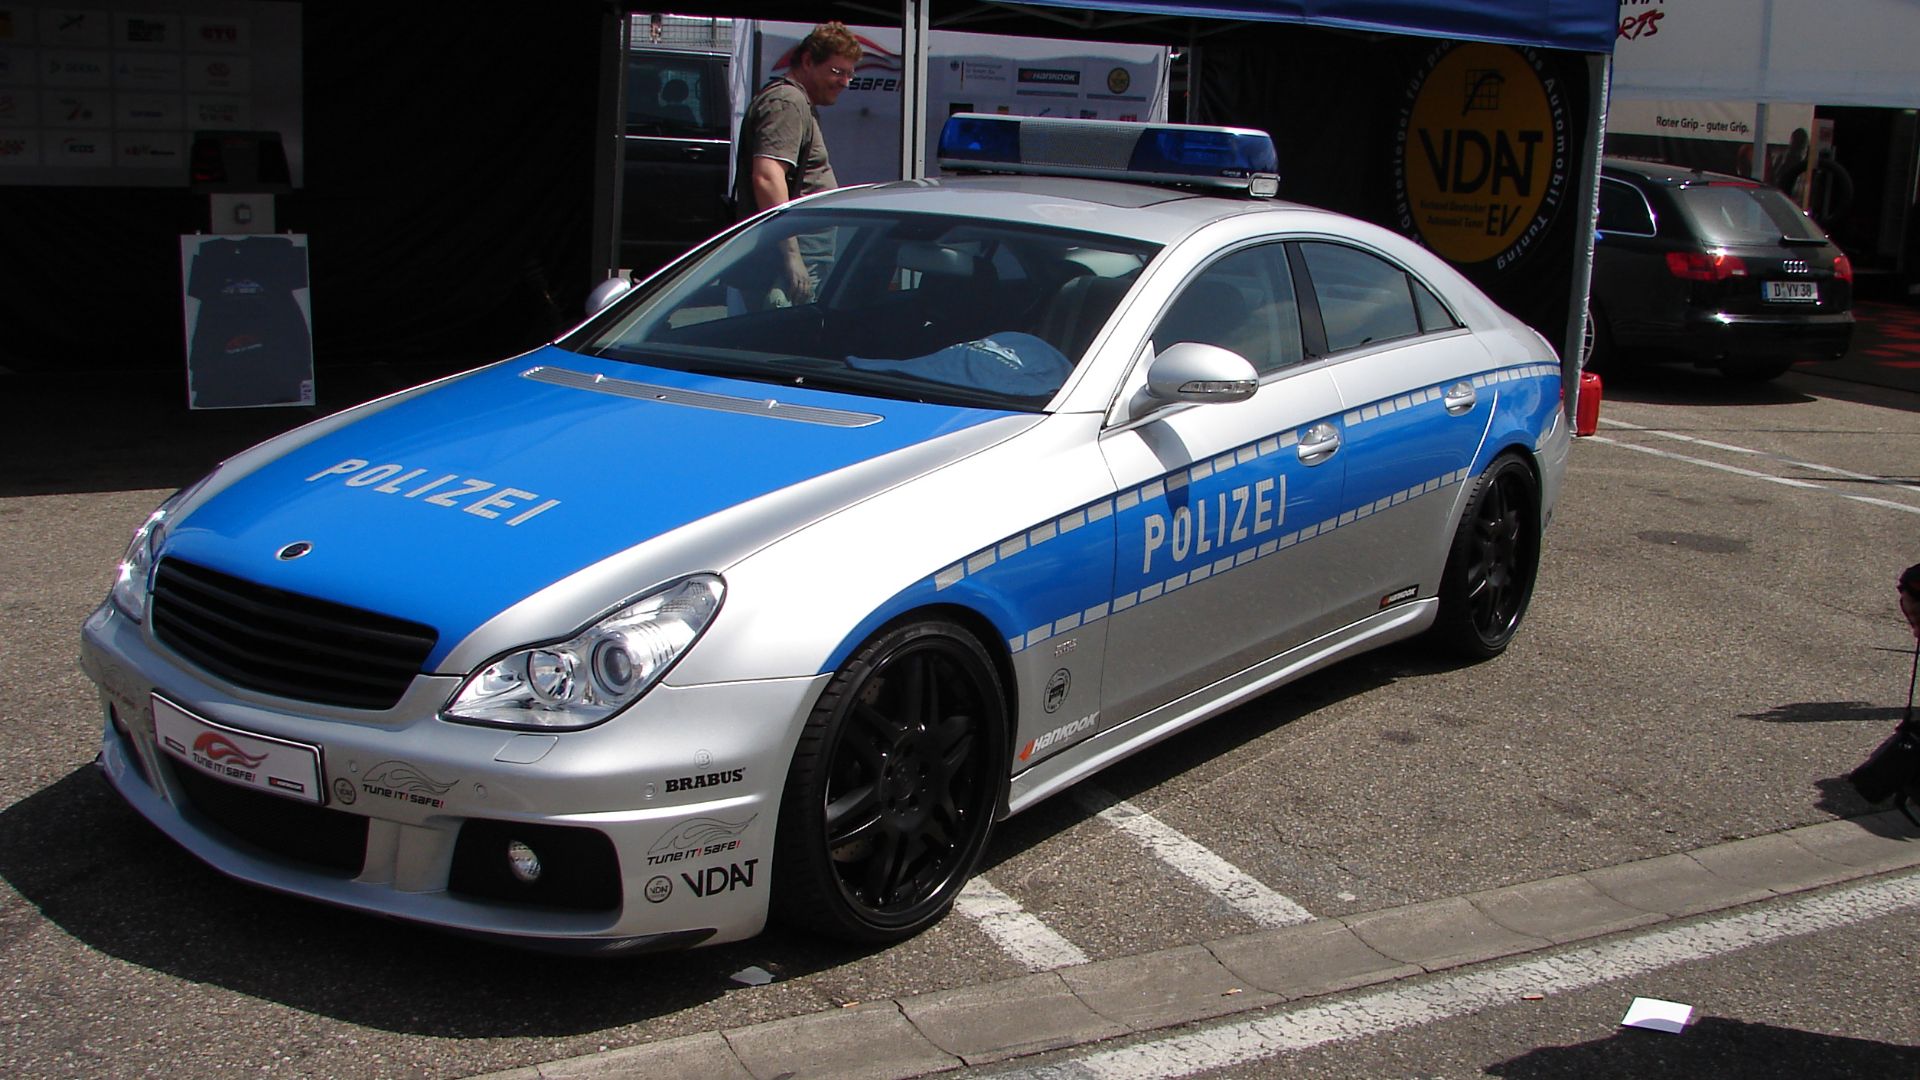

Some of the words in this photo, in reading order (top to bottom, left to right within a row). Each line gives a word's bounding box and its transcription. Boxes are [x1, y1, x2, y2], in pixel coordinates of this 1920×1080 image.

[1616, 9, 1664, 40] RTS
[1656, 116, 1679, 128] Roter
[1680, 118, 1699, 131] Grip
[1706, 121, 1729, 133] guter
[1729, 121, 1750, 135] Grip.
[1418, 128, 1543, 197] VDAT
[1496, 215, 1549, 270] Tuning
[304, 458, 562, 527] POLIZEI
[1143, 473, 1286, 575] POLIZEI
[665, 768, 744, 793] BRABUS
[681, 858, 759, 898] VDAT
